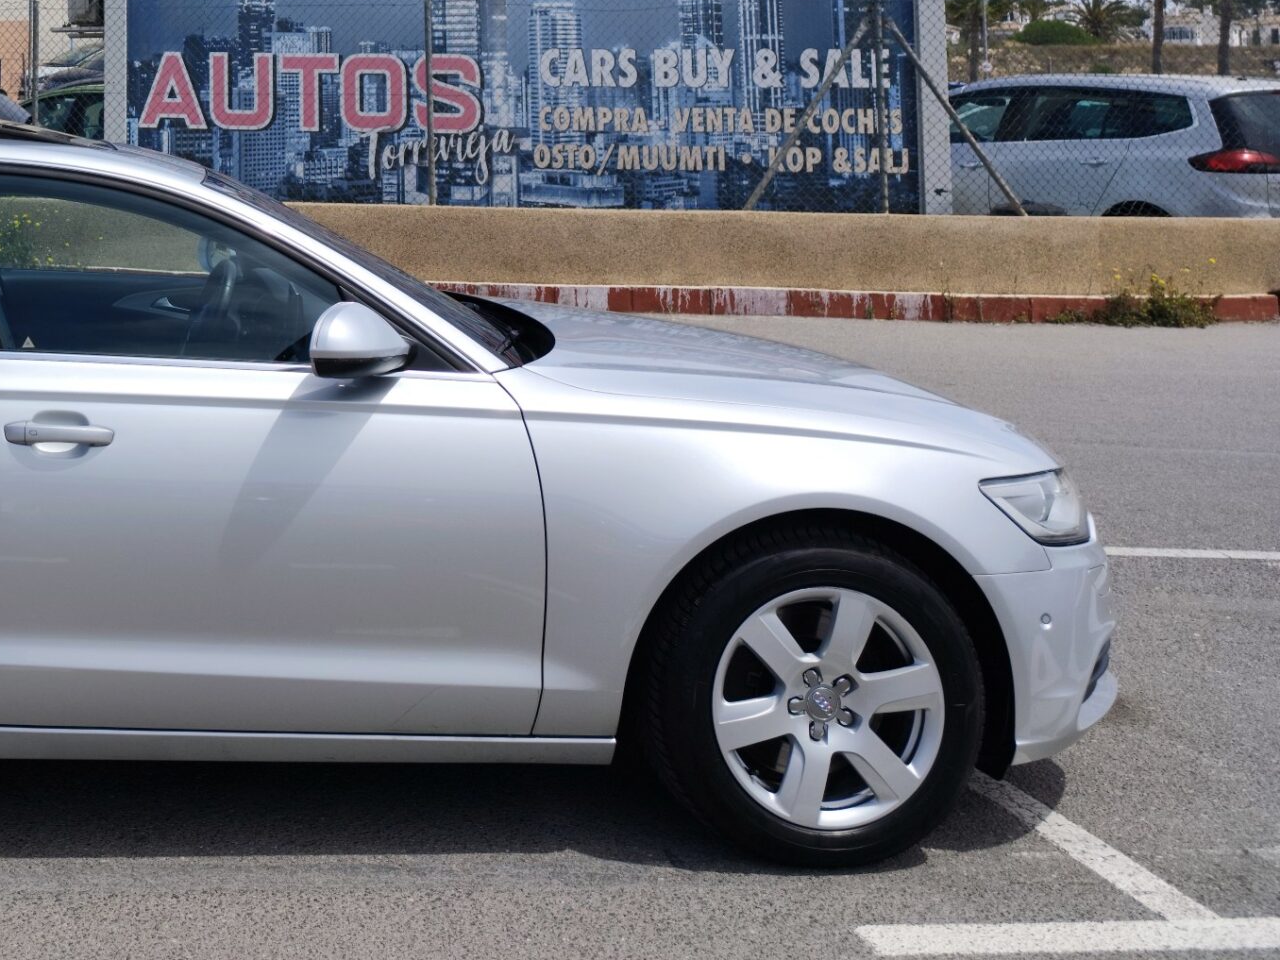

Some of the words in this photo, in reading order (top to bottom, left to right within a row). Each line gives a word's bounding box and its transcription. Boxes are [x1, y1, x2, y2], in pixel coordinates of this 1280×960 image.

[138, 51, 482, 134] AUTOS
[540, 48, 638, 88] CARS
[653, 48, 735, 88] BUY
[752, 48, 784, 88] &
[800, 48, 891, 88] SALE
[539, 106, 649, 132] COMPRA
[674, 107, 754, 133] VENTA
[765, 108, 796, 133] DE
[359, 124, 516, 185] Torrevieja
